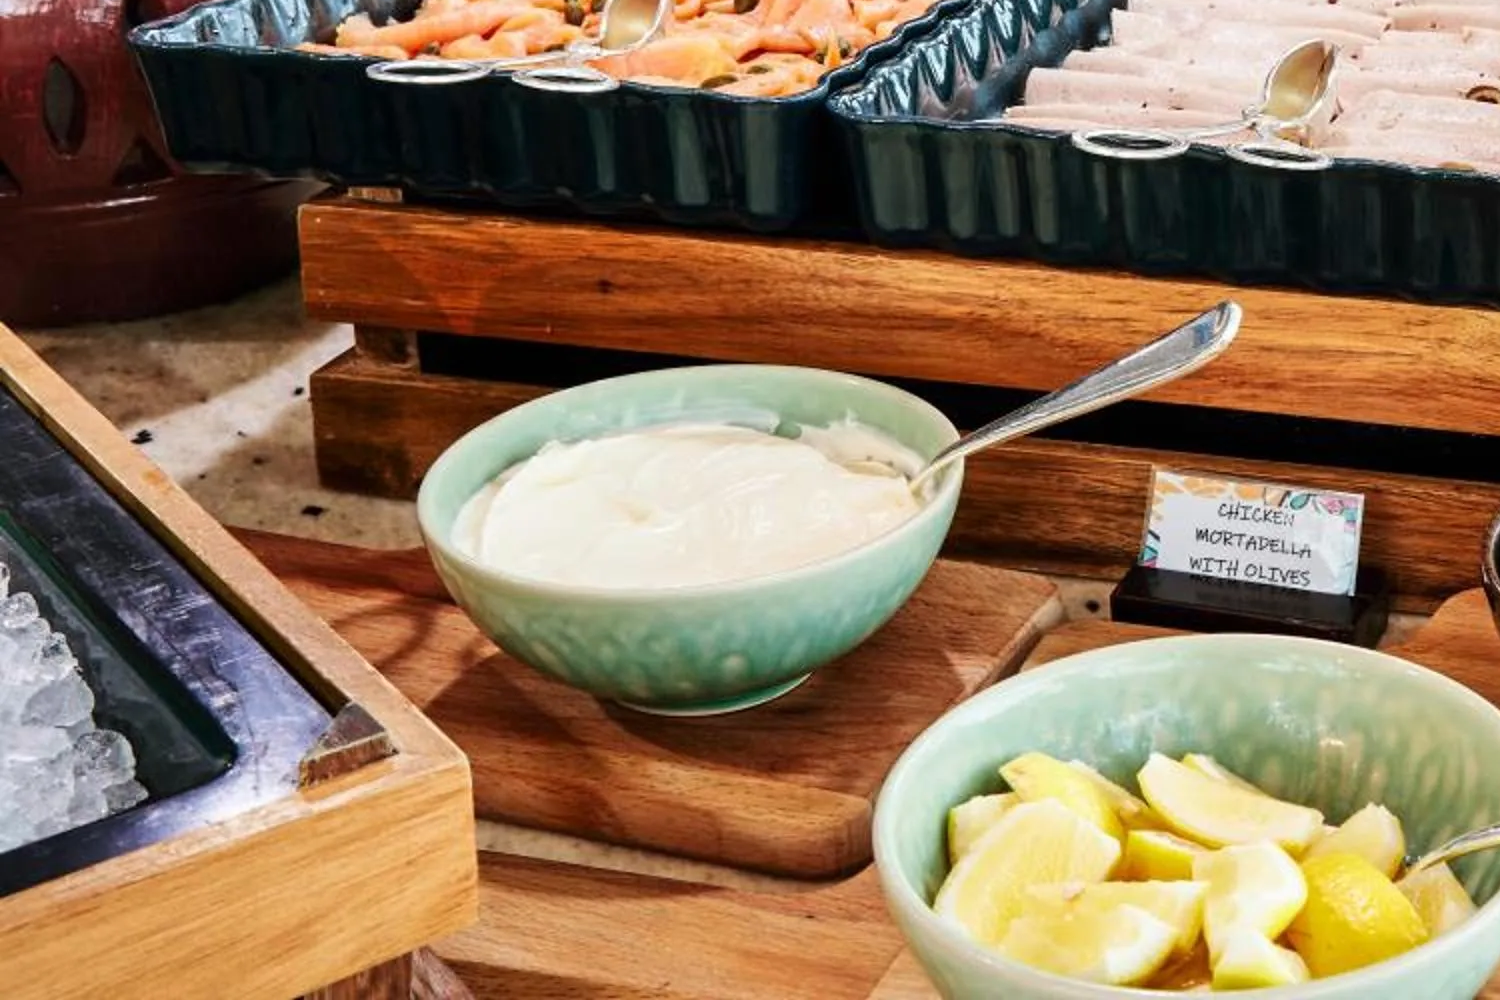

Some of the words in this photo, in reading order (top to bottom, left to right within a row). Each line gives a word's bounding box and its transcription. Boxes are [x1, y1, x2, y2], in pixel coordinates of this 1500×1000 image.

[1217, 502, 1295, 527] CHICKEN
[1195, 527, 1312, 558] MORTADELLA
[1189, 556, 1239, 577] WITH
[1243, 563, 1312, 586] OLIVES
